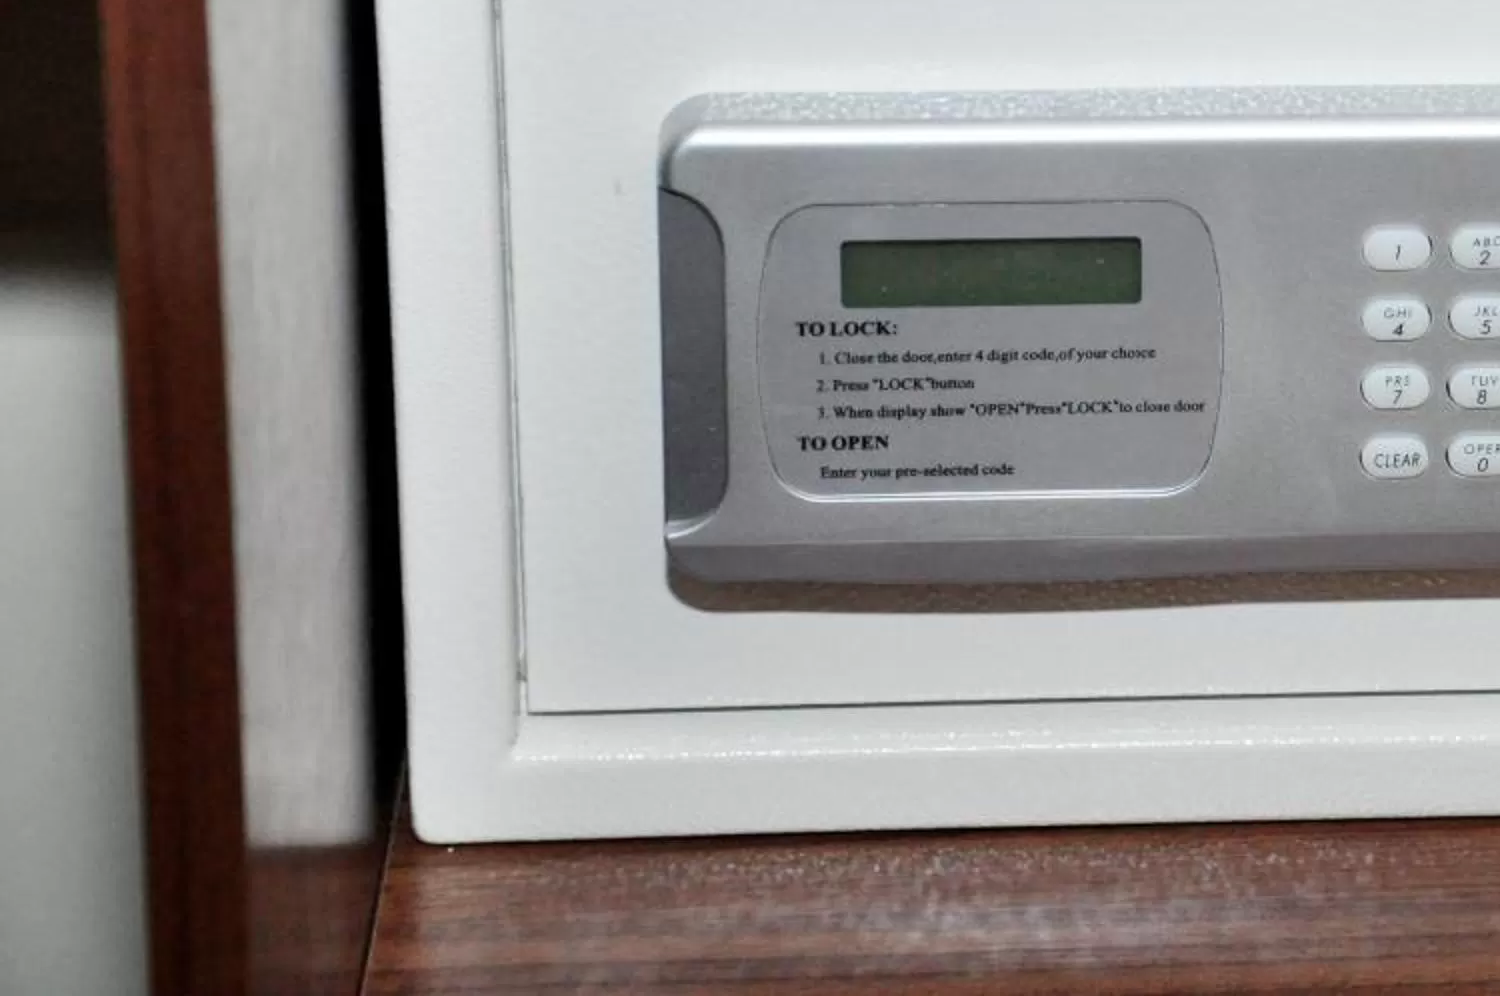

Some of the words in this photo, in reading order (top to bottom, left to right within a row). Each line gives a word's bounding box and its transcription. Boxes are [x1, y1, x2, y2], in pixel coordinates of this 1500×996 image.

[1394, 244, 1402, 261] 1
[1479, 250, 1492, 265] 2
[1383, 307, 1413, 319] GHI
[1474, 306, 1499, 317] JKL
[796, 321, 825, 337] TO
[830, 320, 898, 337] LOCK:
[1392, 323, 1405, 336] 4
[1479, 320, 1492, 335] 5
[819, 352, 831, 365] 1.
[834, 351, 873, 365] Close
[877, 350, 899, 364] the
[975, 350, 983, 362] 4
[987, 349, 1019, 364] digit
[1076, 350, 1108, 363] your
[1111, 346, 1157, 360] choice
[816, 379, 830, 393] 2.
[833, 379, 869, 392] Press
[1385, 376, 1411, 387] PRS
[1471, 375, 1499, 387] TUV
[1392, 390, 1403, 404] 7
[1476, 390, 1488, 404] 8
[833, 405, 873, 419] When
[877, 404, 927, 420] display
[930, 404, 966, 417] show
[1136, 401, 1170, 413] close
[1173, 400, 1205, 413] door
[797, 436, 827, 451] TO
[831, 435, 889, 451] OPEN
[1374, 452, 1421, 469] CLEAR
[1477, 457, 1489, 472] 0
[820, 466, 857, 479] Enter
[861, 468, 891, 480] your
[895, 464, 979, 479] pre-selected
[982, 463, 1016, 476] code
